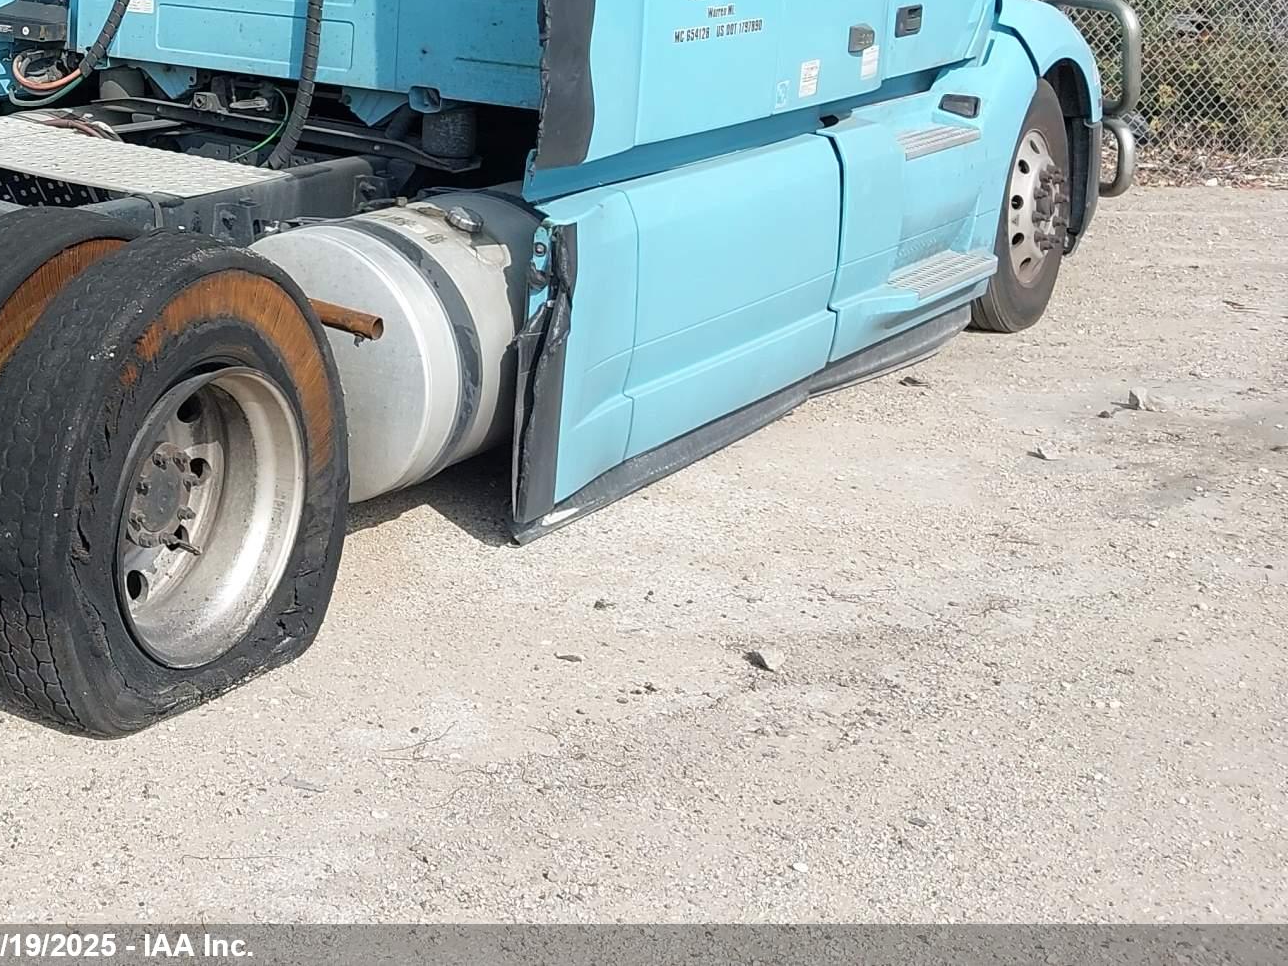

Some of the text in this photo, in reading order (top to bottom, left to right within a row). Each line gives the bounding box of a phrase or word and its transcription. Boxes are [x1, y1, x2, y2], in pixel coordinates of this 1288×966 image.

[674, 30, 685, 42] MC
[716, 24, 725, 37] US
[726, 22, 737, 36] DOT
